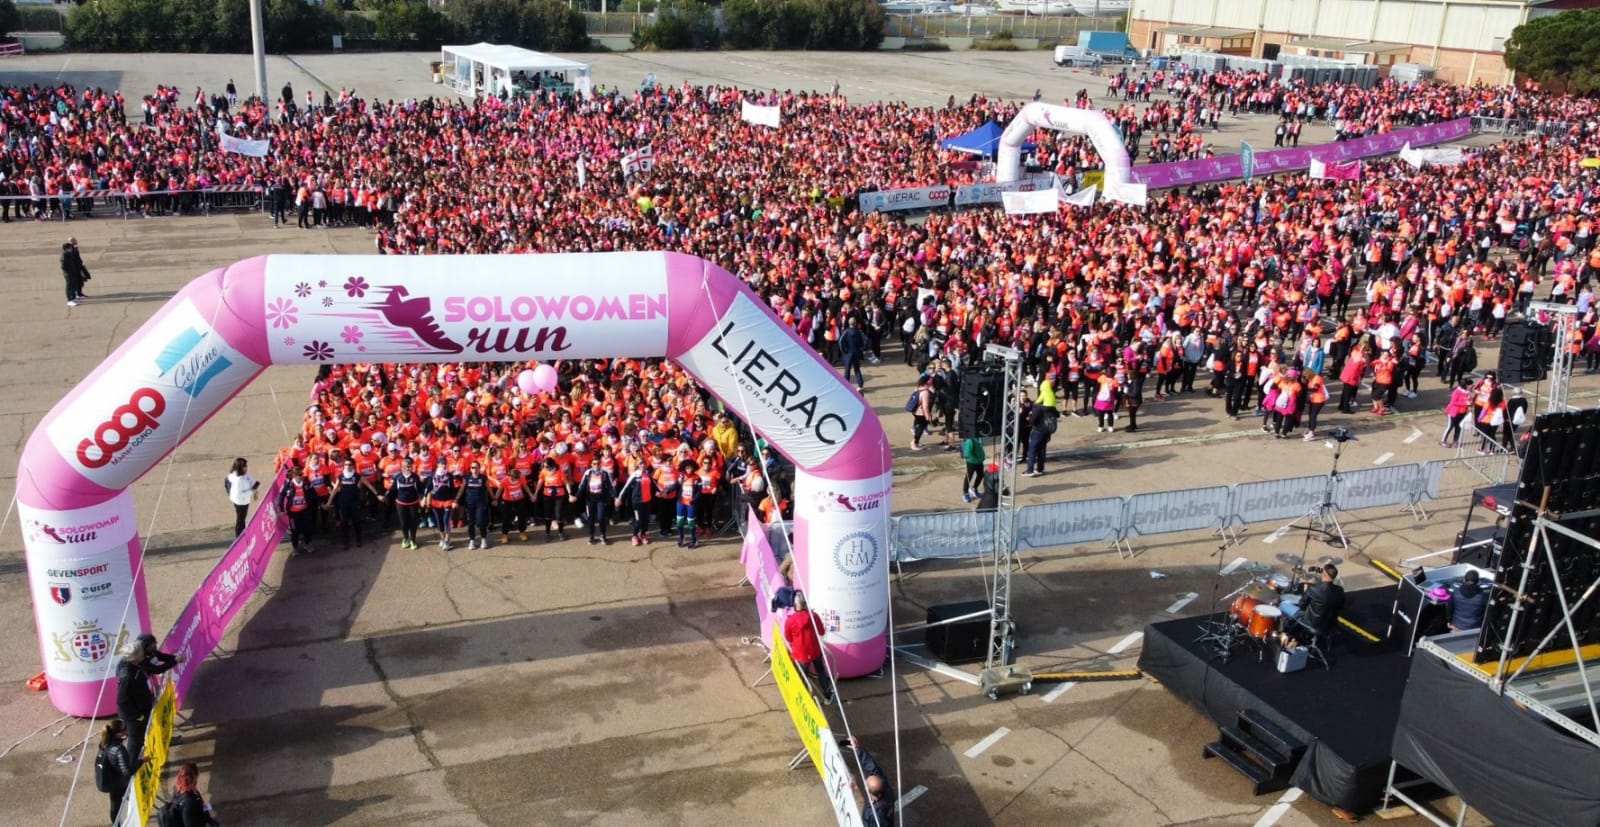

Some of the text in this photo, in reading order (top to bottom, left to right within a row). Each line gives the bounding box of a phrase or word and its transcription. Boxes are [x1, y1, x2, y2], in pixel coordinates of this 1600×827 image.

[929, 190, 949, 200] coop
[444, 294, 667, 322] SOLOWOMEN
[466, 326, 572, 353] run
[711, 321, 847, 445] LIERAC
[76, 387, 166, 469] coop
[857, 499, 879, 511] run
[59, 514, 120, 534] SOLOWOMEN
[66, 531, 98, 543] run
[90, 582, 112, 592] UISP
